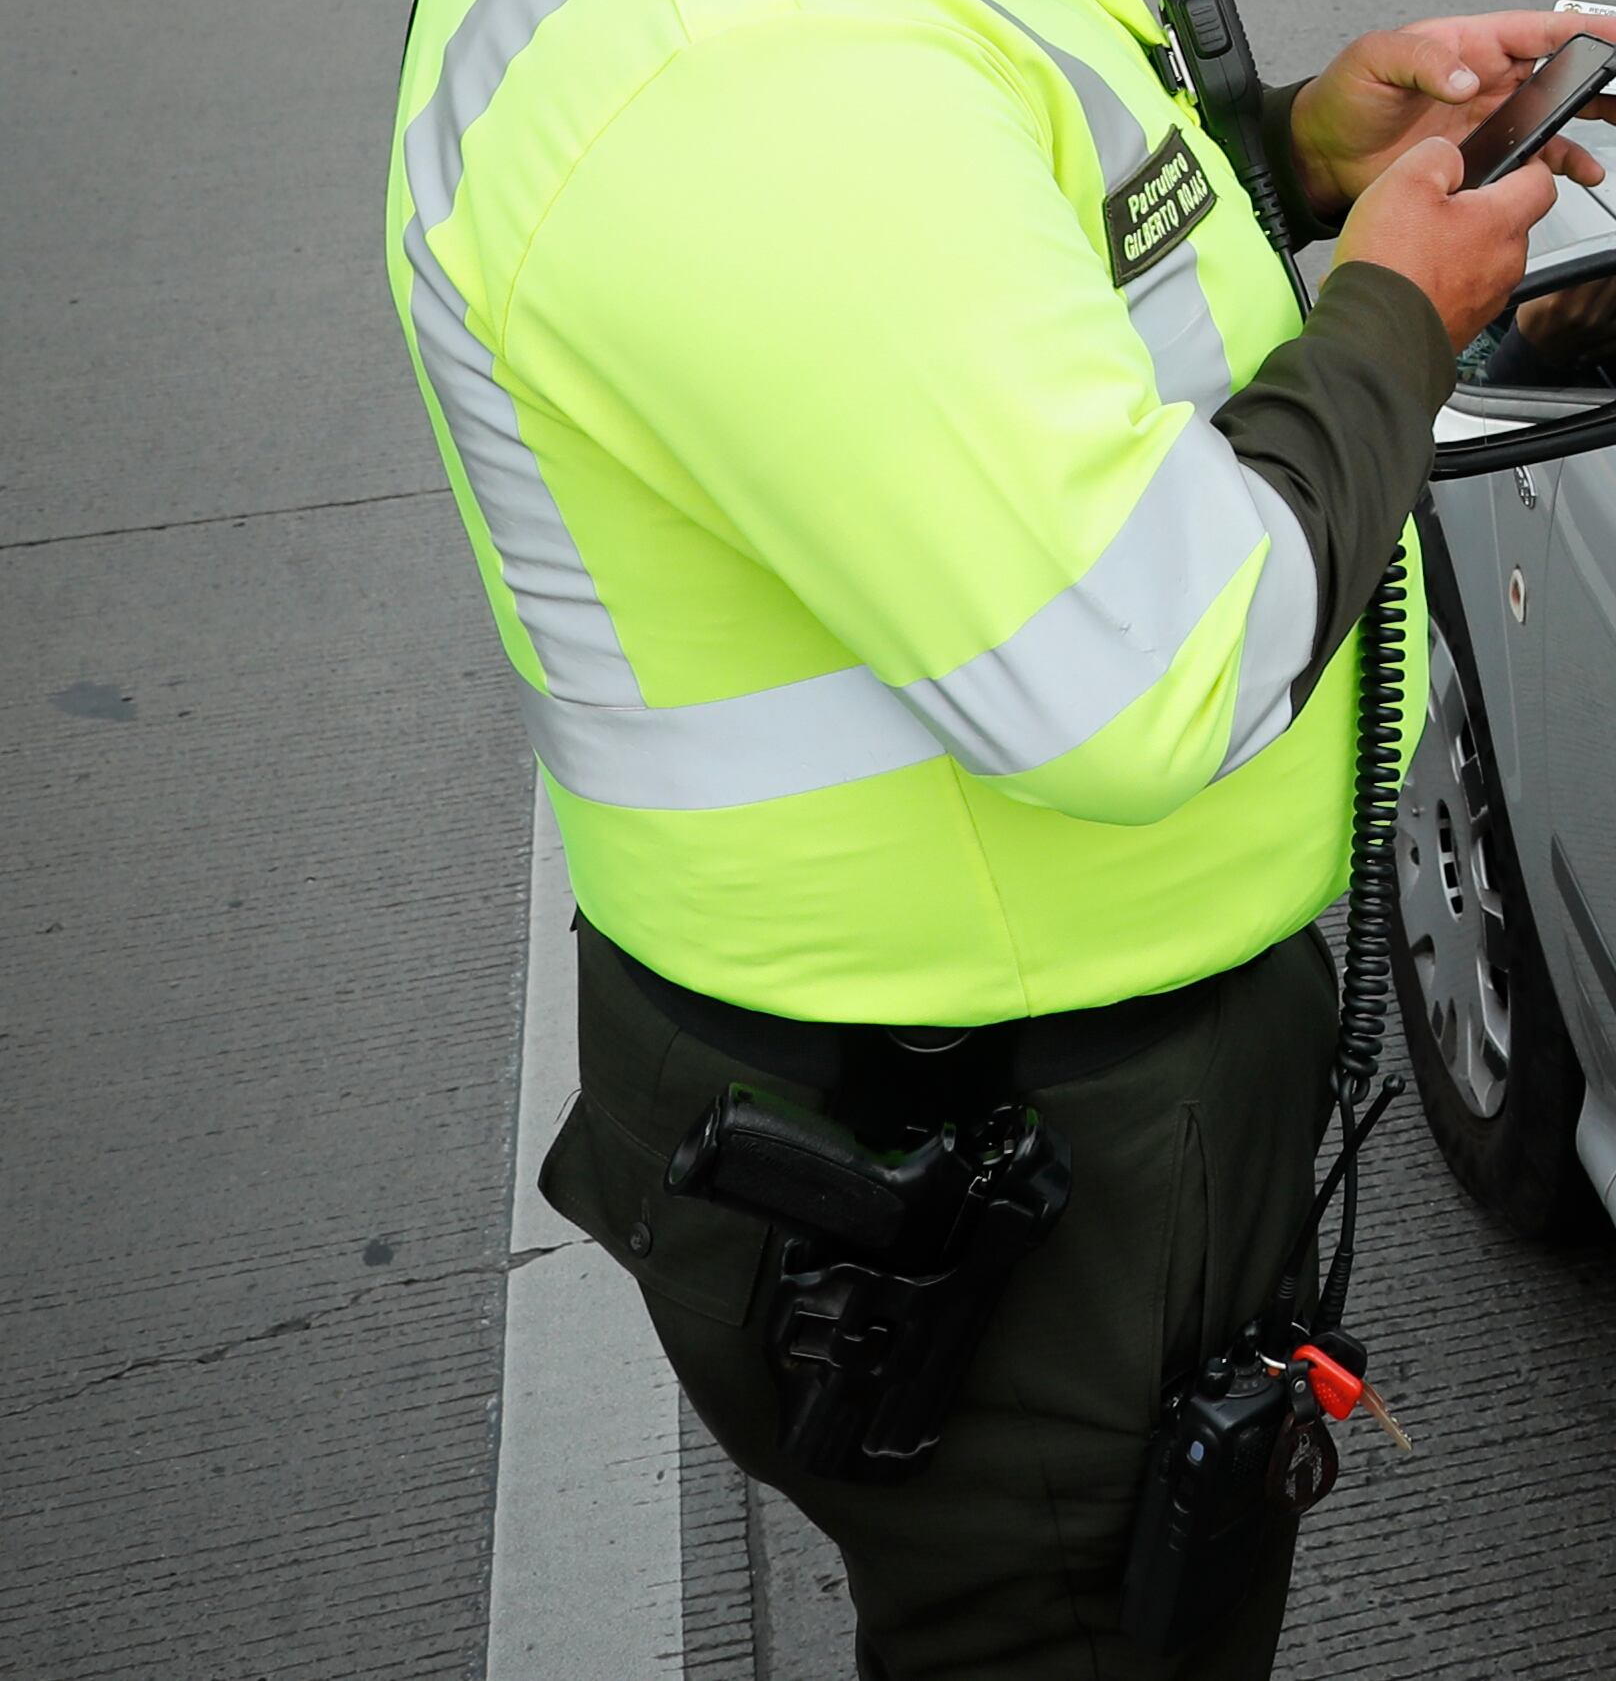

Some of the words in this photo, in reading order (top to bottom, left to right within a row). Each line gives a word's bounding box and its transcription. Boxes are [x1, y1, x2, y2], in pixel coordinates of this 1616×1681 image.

[1124, 198, 1180, 262] GILBERTO
[1176, 169, 1209, 216] ROJAS
[1127, 152, 1189, 224] Patrullero
